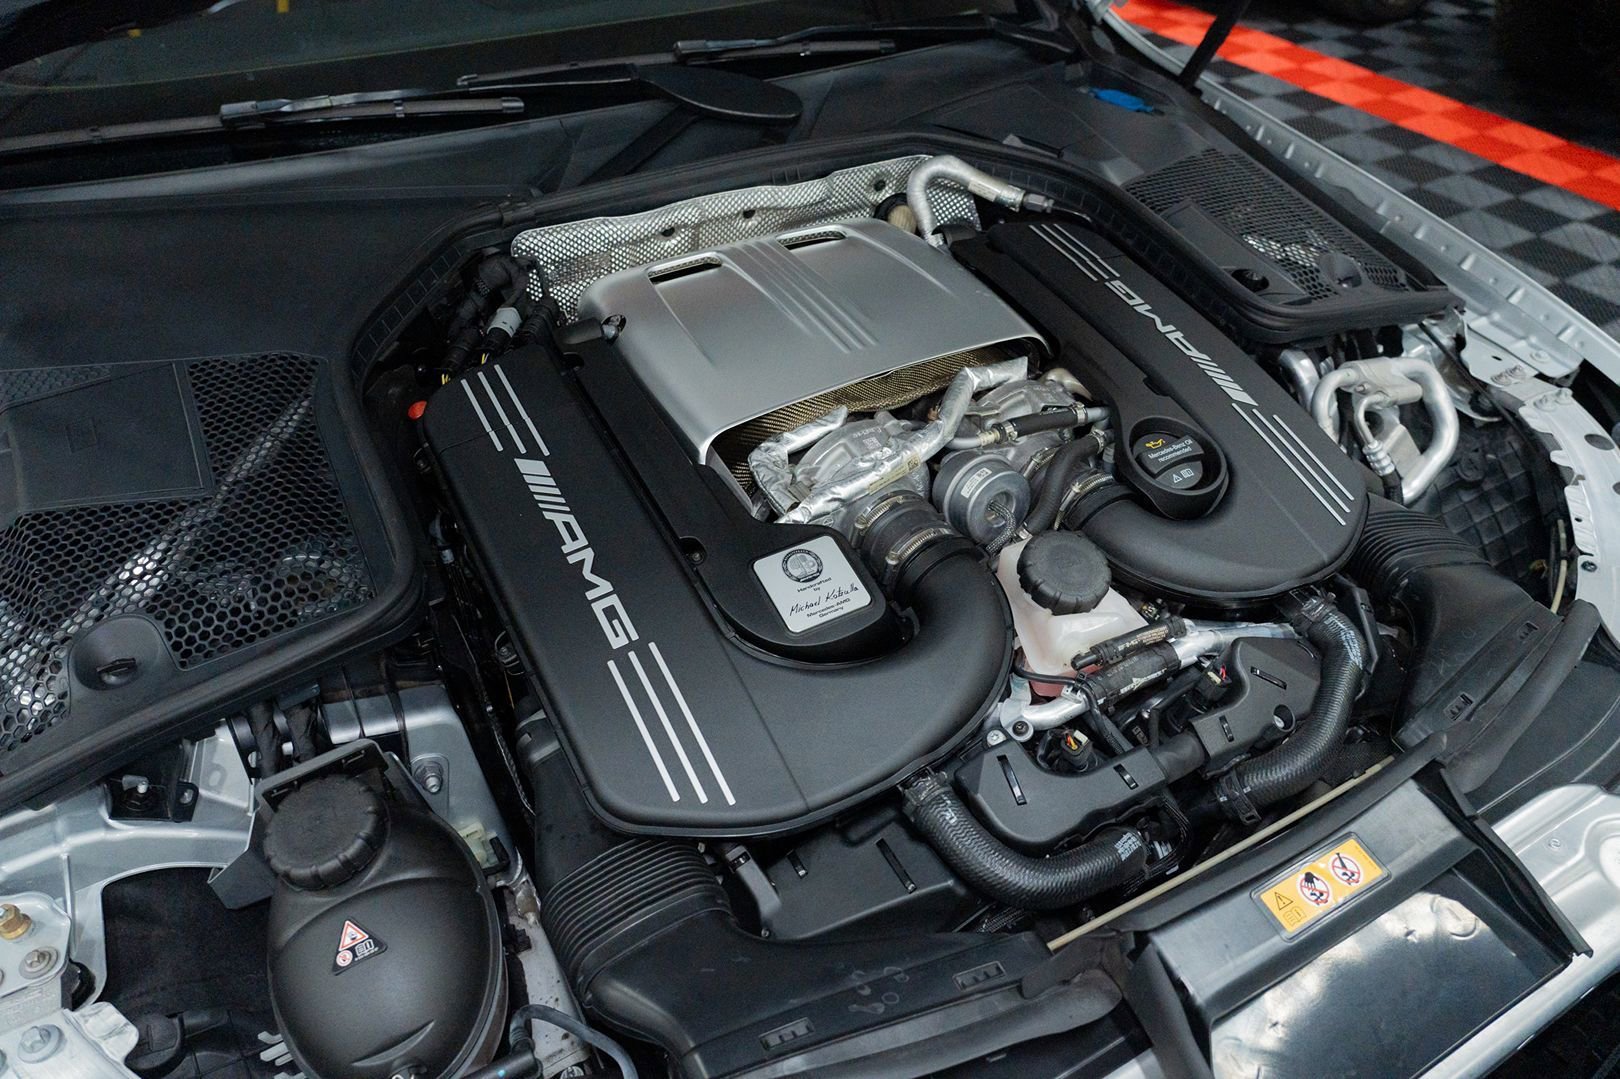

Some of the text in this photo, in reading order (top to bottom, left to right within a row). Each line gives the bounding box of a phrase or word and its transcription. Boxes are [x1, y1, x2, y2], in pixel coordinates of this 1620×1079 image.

[1105, 280, 1211, 361] AMG
[1148, 440, 1186, 459] Mercedes-Benz
[542, 511, 639, 650] AMG
[797, 577, 832, 592] Handcrafted
[789, 596, 821, 616] Michael
[819, 606, 844, 617] Germany
